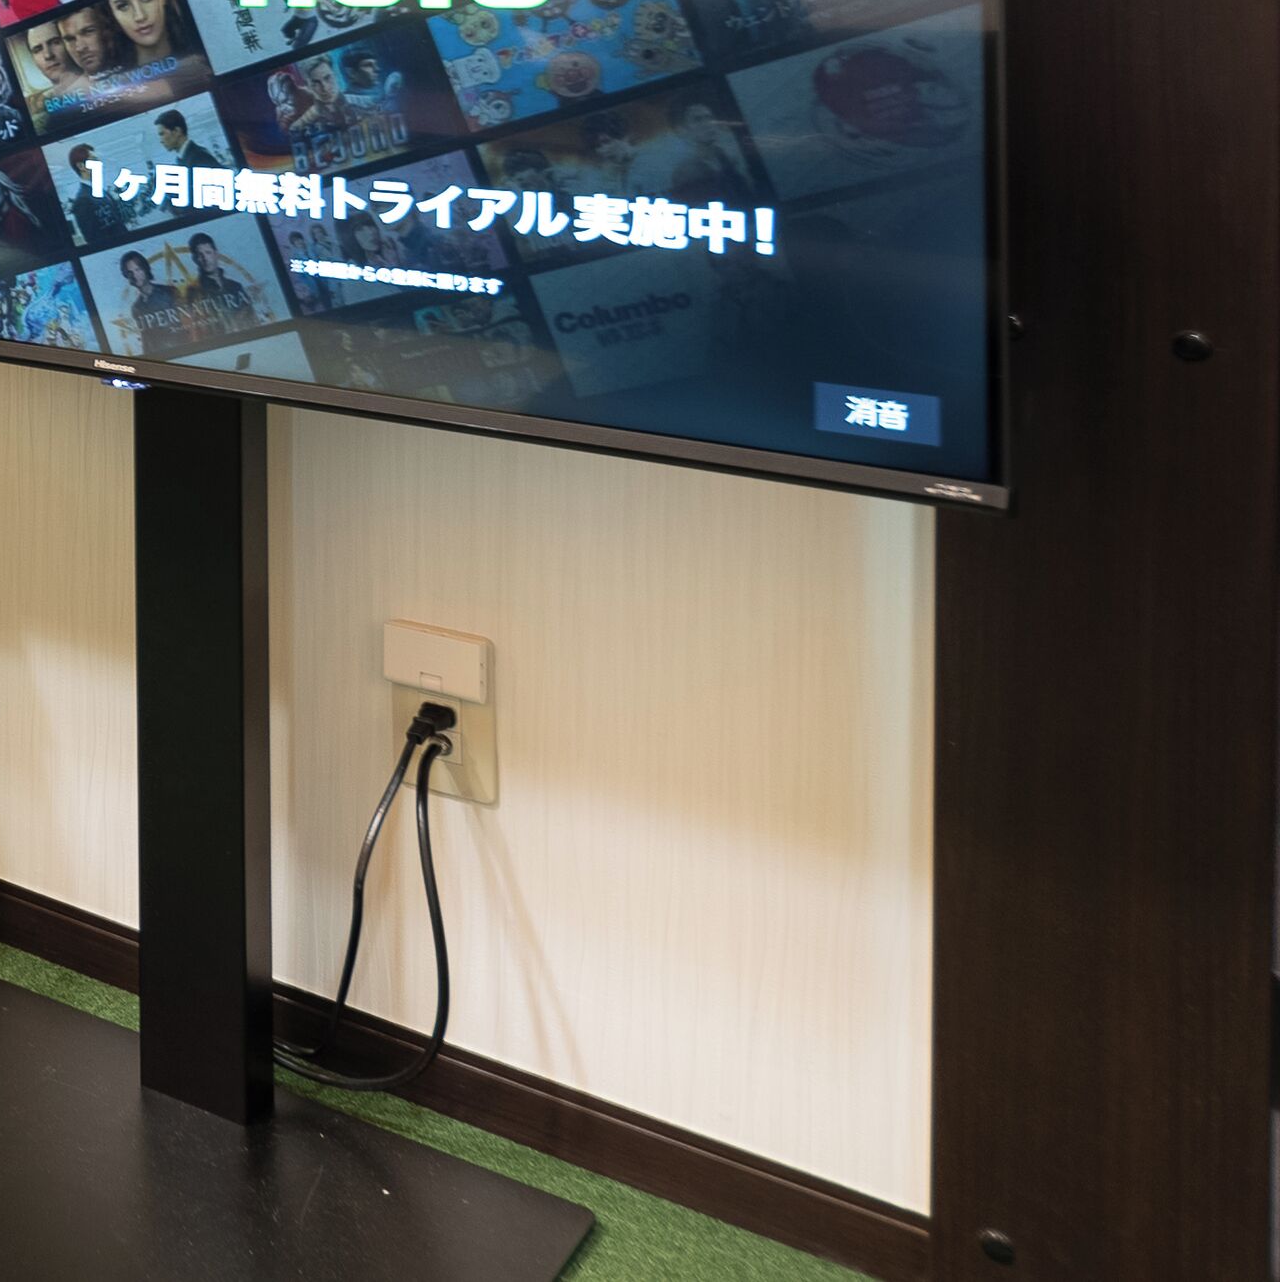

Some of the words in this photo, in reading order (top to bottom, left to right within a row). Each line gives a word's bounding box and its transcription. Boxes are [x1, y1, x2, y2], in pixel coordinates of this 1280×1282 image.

[44, 91, 85, 114] BRAVE
[90, 75, 128, 100] NEW
[130, 56, 180, 87] WORLD
[85, 159, 776, 256] 1ヶ月間無料トライアル実施中!
[555, 291, 691, 334] Columbo
[844, 395, 910, 432] 消音
